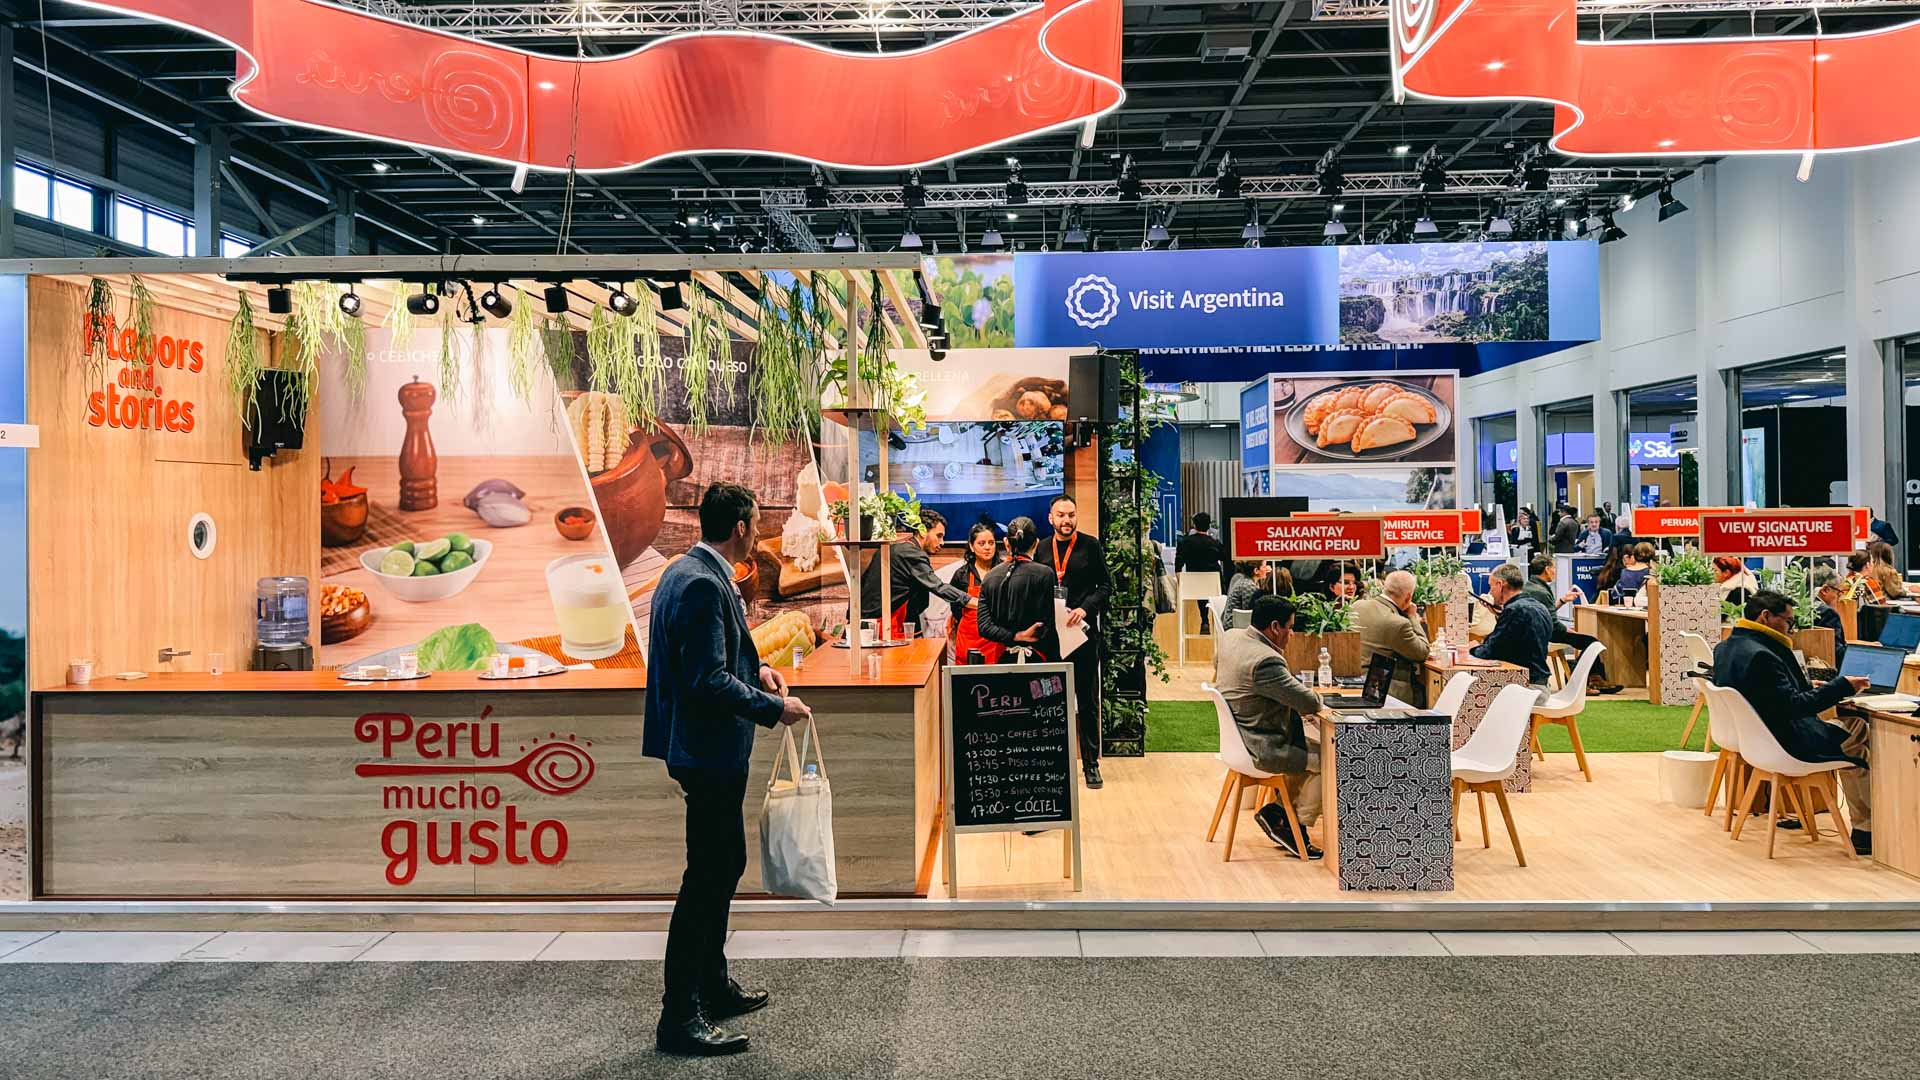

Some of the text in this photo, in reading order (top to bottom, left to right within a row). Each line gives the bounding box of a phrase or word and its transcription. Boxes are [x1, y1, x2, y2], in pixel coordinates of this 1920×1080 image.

[1128, 287, 1285, 313] Visit Argentina
[118, 365, 155, 391] and
[88, 382, 196, 433] stories
[1660, 518, 1699, 527] PERURA
[1719, 520, 1833, 534] VIEW SIGNATURE
[1266, 526, 1345, 538] SALKANTAY
[1400, 530, 1445, 540] SERVICE
[1255, 539, 1360, 552] TREKKING PERU
[1748, 535, 1808, 547] TRAVELS
[354, 704, 501, 759] Perú
[964, 731, 999, 745] 10:30
[1007, 729, 1038, 739] COFFEE
[1041, 727, 1066, 737] SHOW
[965, 748, 997, 759] 13:00
[967, 758, 999, 772] 13:45
[1008, 757, 1029, 768] PISCO
[1031, 758, 1055, 767] SHOW
[969, 774, 999, 787] 14:30
[1008, 771, 1041, 782] COFFEE
[1044, 772, 1066, 782] SHOW
[383, 779, 502, 810] mucho
[969, 787, 1001, 802] 15:30
[970, 801, 1005, 818] 17:00
[1015, 795, 1063, 814] CÓCTEL
[381, 804, 570, 886] gusto
